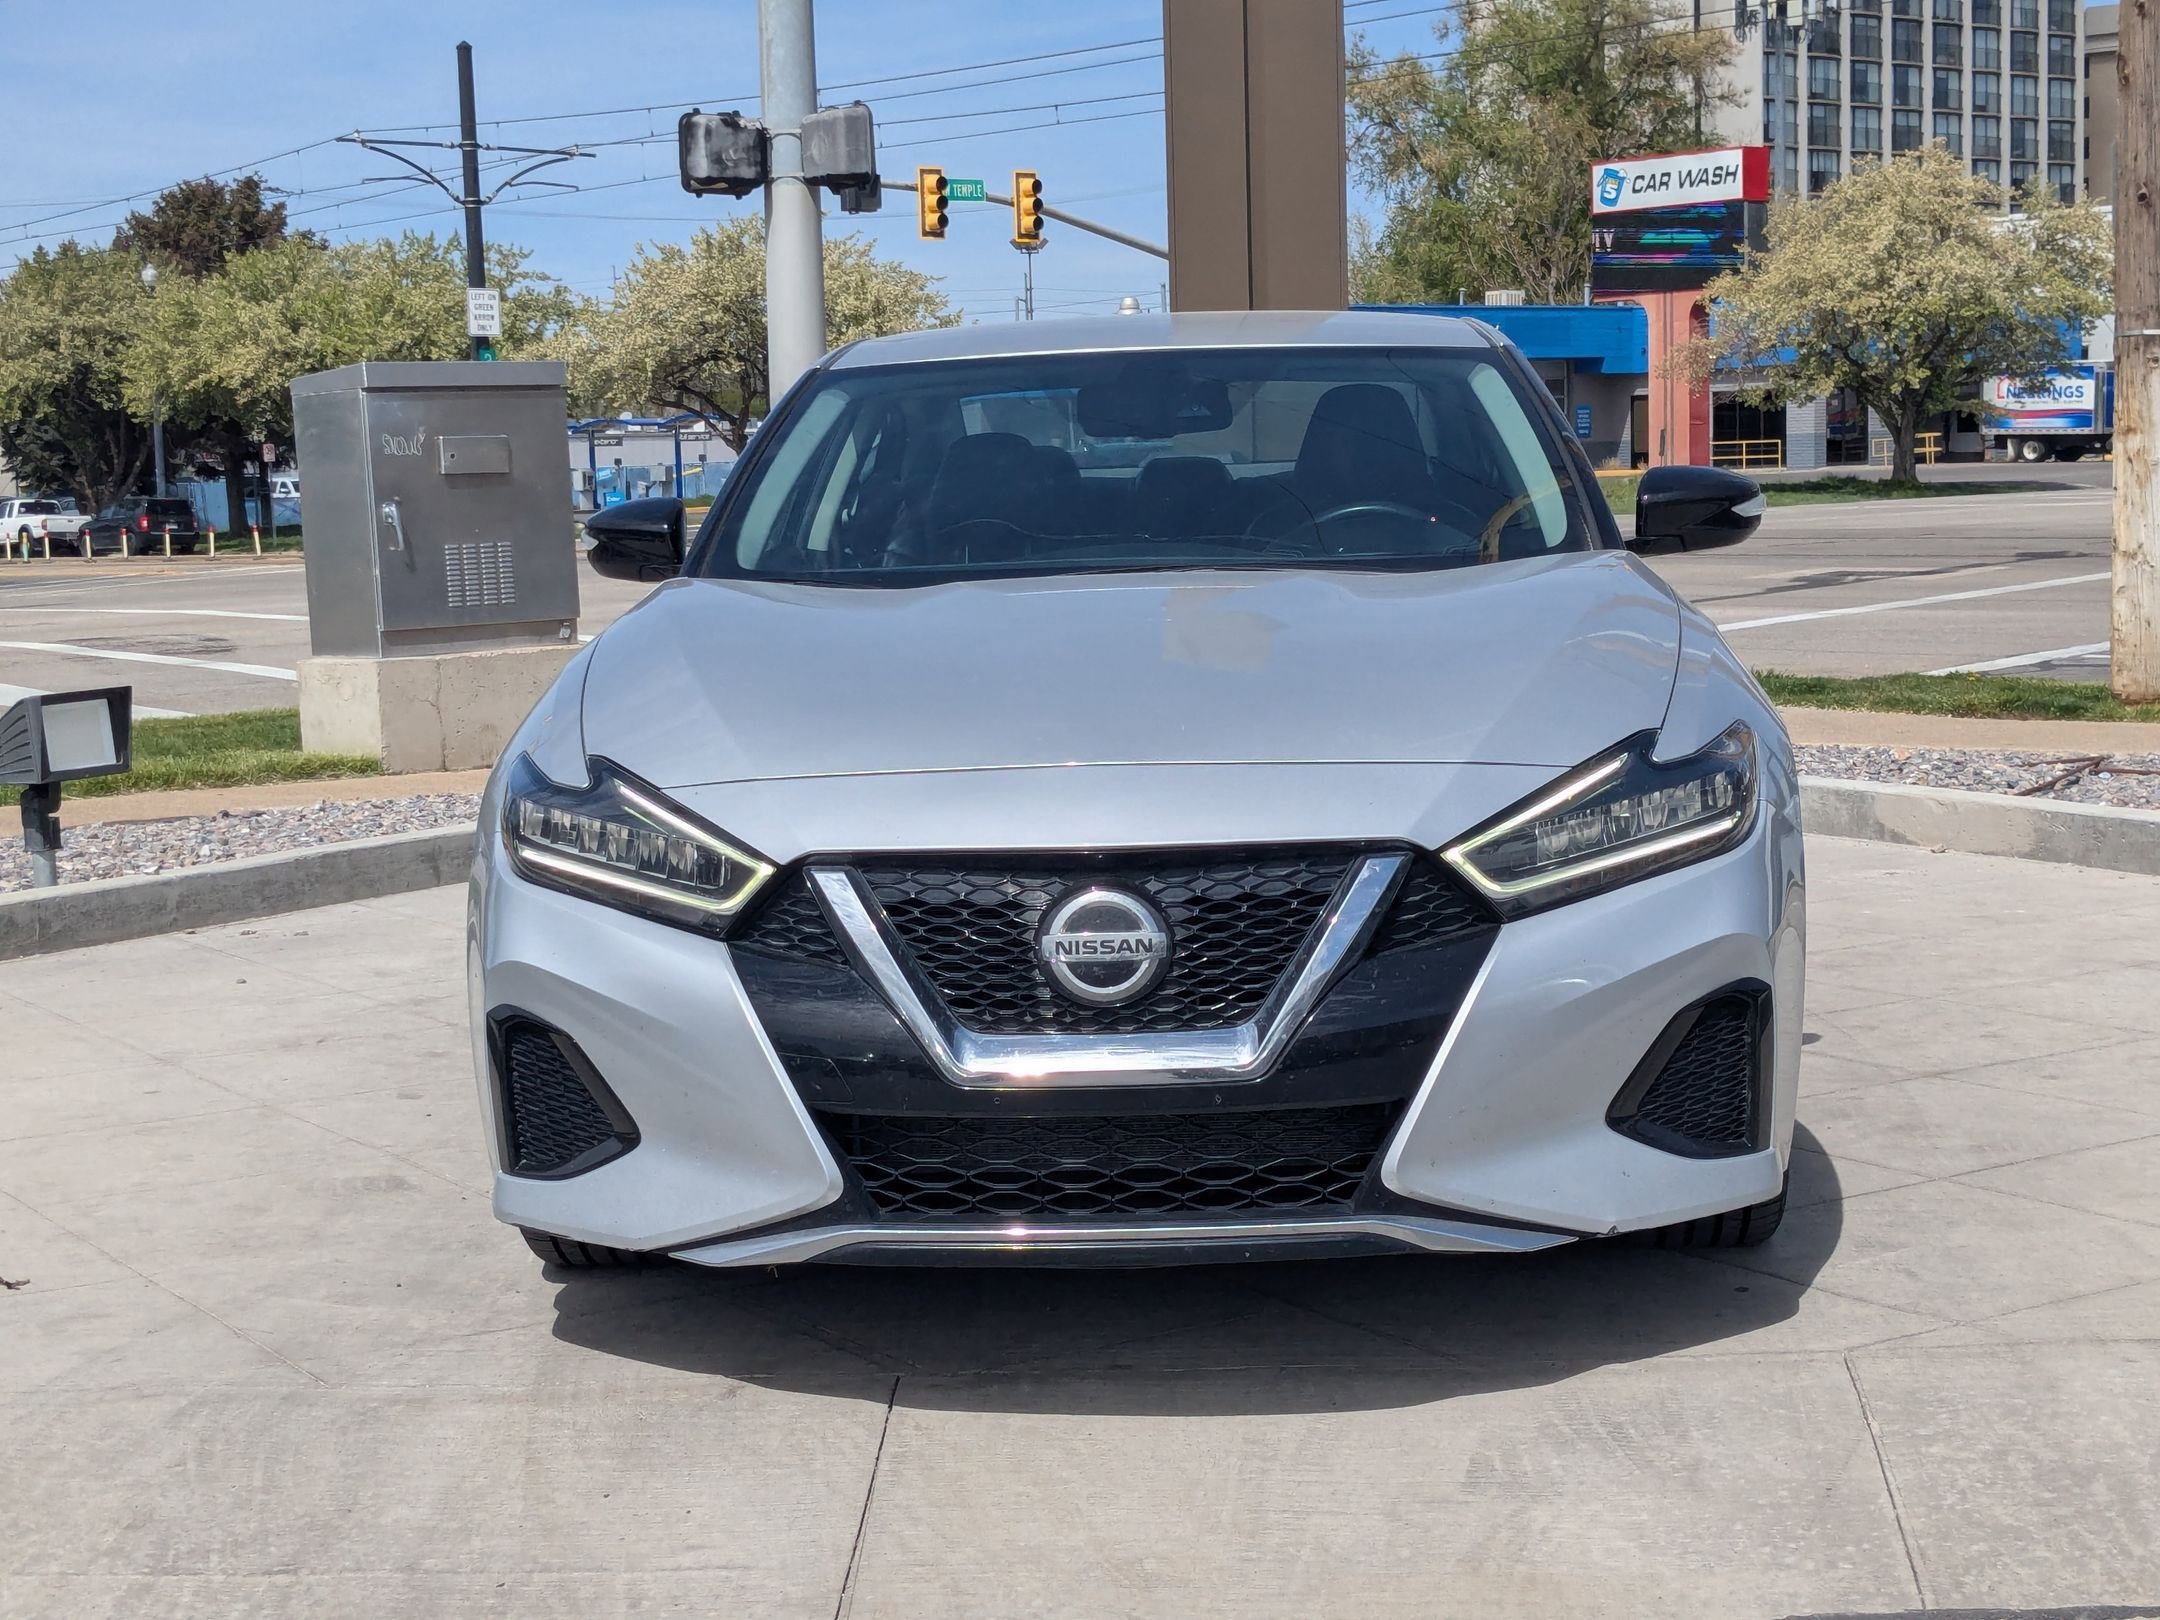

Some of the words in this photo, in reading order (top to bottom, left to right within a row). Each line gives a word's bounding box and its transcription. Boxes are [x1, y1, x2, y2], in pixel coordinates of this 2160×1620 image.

[1632, 172, 1671, 194] CAR
[1678, 164, 1739, 189] WASH
[953, 184, 982, 197] TEMPLE
[1603, 183, 1617, 200] 5
[471, 293, 485, 301] LEFT
[474, 303, 494, 311] GREEN
[474, 313, 495, 321] ARROW
[477, 324, 493, 332] ONLY
[1055, 938, 1154, 956] NISSAN
